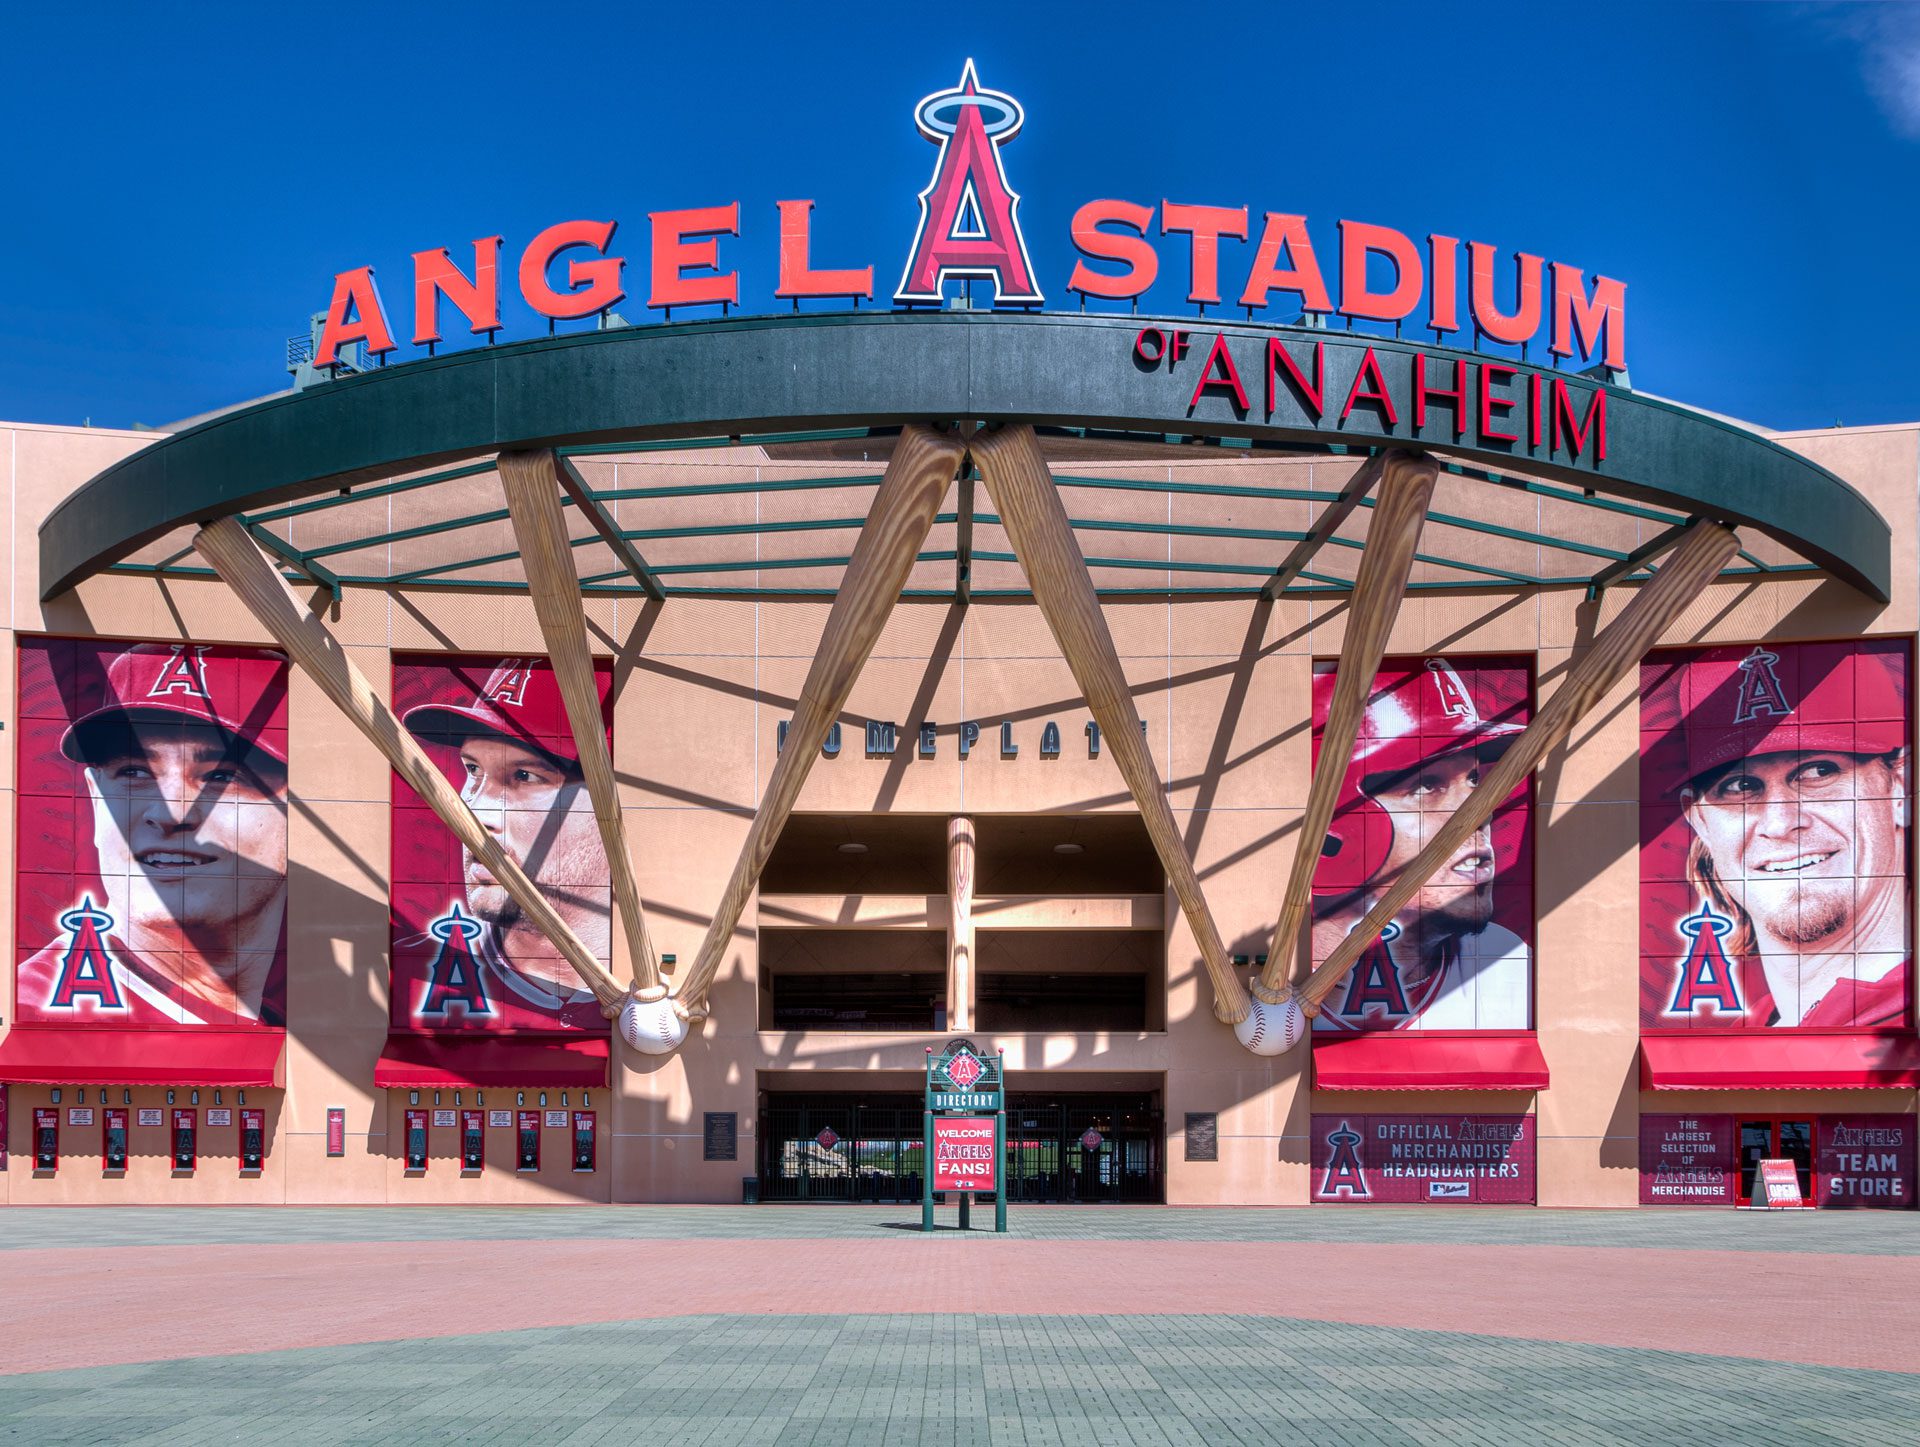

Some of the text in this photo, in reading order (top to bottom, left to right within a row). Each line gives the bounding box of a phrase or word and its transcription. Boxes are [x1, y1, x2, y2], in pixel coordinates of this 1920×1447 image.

[893, 57, 1045, 305] A
[313, 198, 1628, 371] ANGEL STADIUM
[1136, 327, 1606, 462] OF ANAHEIM
[49, 893, 125, 1010] A
[420, 902, 493, 1013] A
[1668, 899, 1745, 1013] A
[51, 1088, 246, 1105] WILL CALL
[409, 1090, 591, 1107] WILL CALL
[936, 1094, 993, 1106] DIRECTORY
[576, 1120, 593, 1130] VIP
[937, 1129, 992, 1138] WELCOME
[1377, 1117, 1524, 1141] OFFICIAL ANGELS
[1679, 1120, 1698, 1130] THE
[1664, 1132, 1711, 1142] LARGEST
[1831, 1121, 1903, 1147] ANGELS
[937, 1139, 992, 1160] ANGELS
[1391, 1143, 1511, 1159] MERCHANDISE
[1661, 1144, 1716, 1153] SELECTION
[938, 1163, 990, 1174] FANS!
[1682, 1156, 1695, 1165] OF
[1836, 1153, 1897, 1172] TEAM
[1383, 1163, 1520, 1179] HEADQUARTERS
[1655, 1159, 1724, 1184] ANGELS
[1651, 1186, 1726, 1196] MERCHANDISE
[1830, 1177, 1903, 1196] STORE
